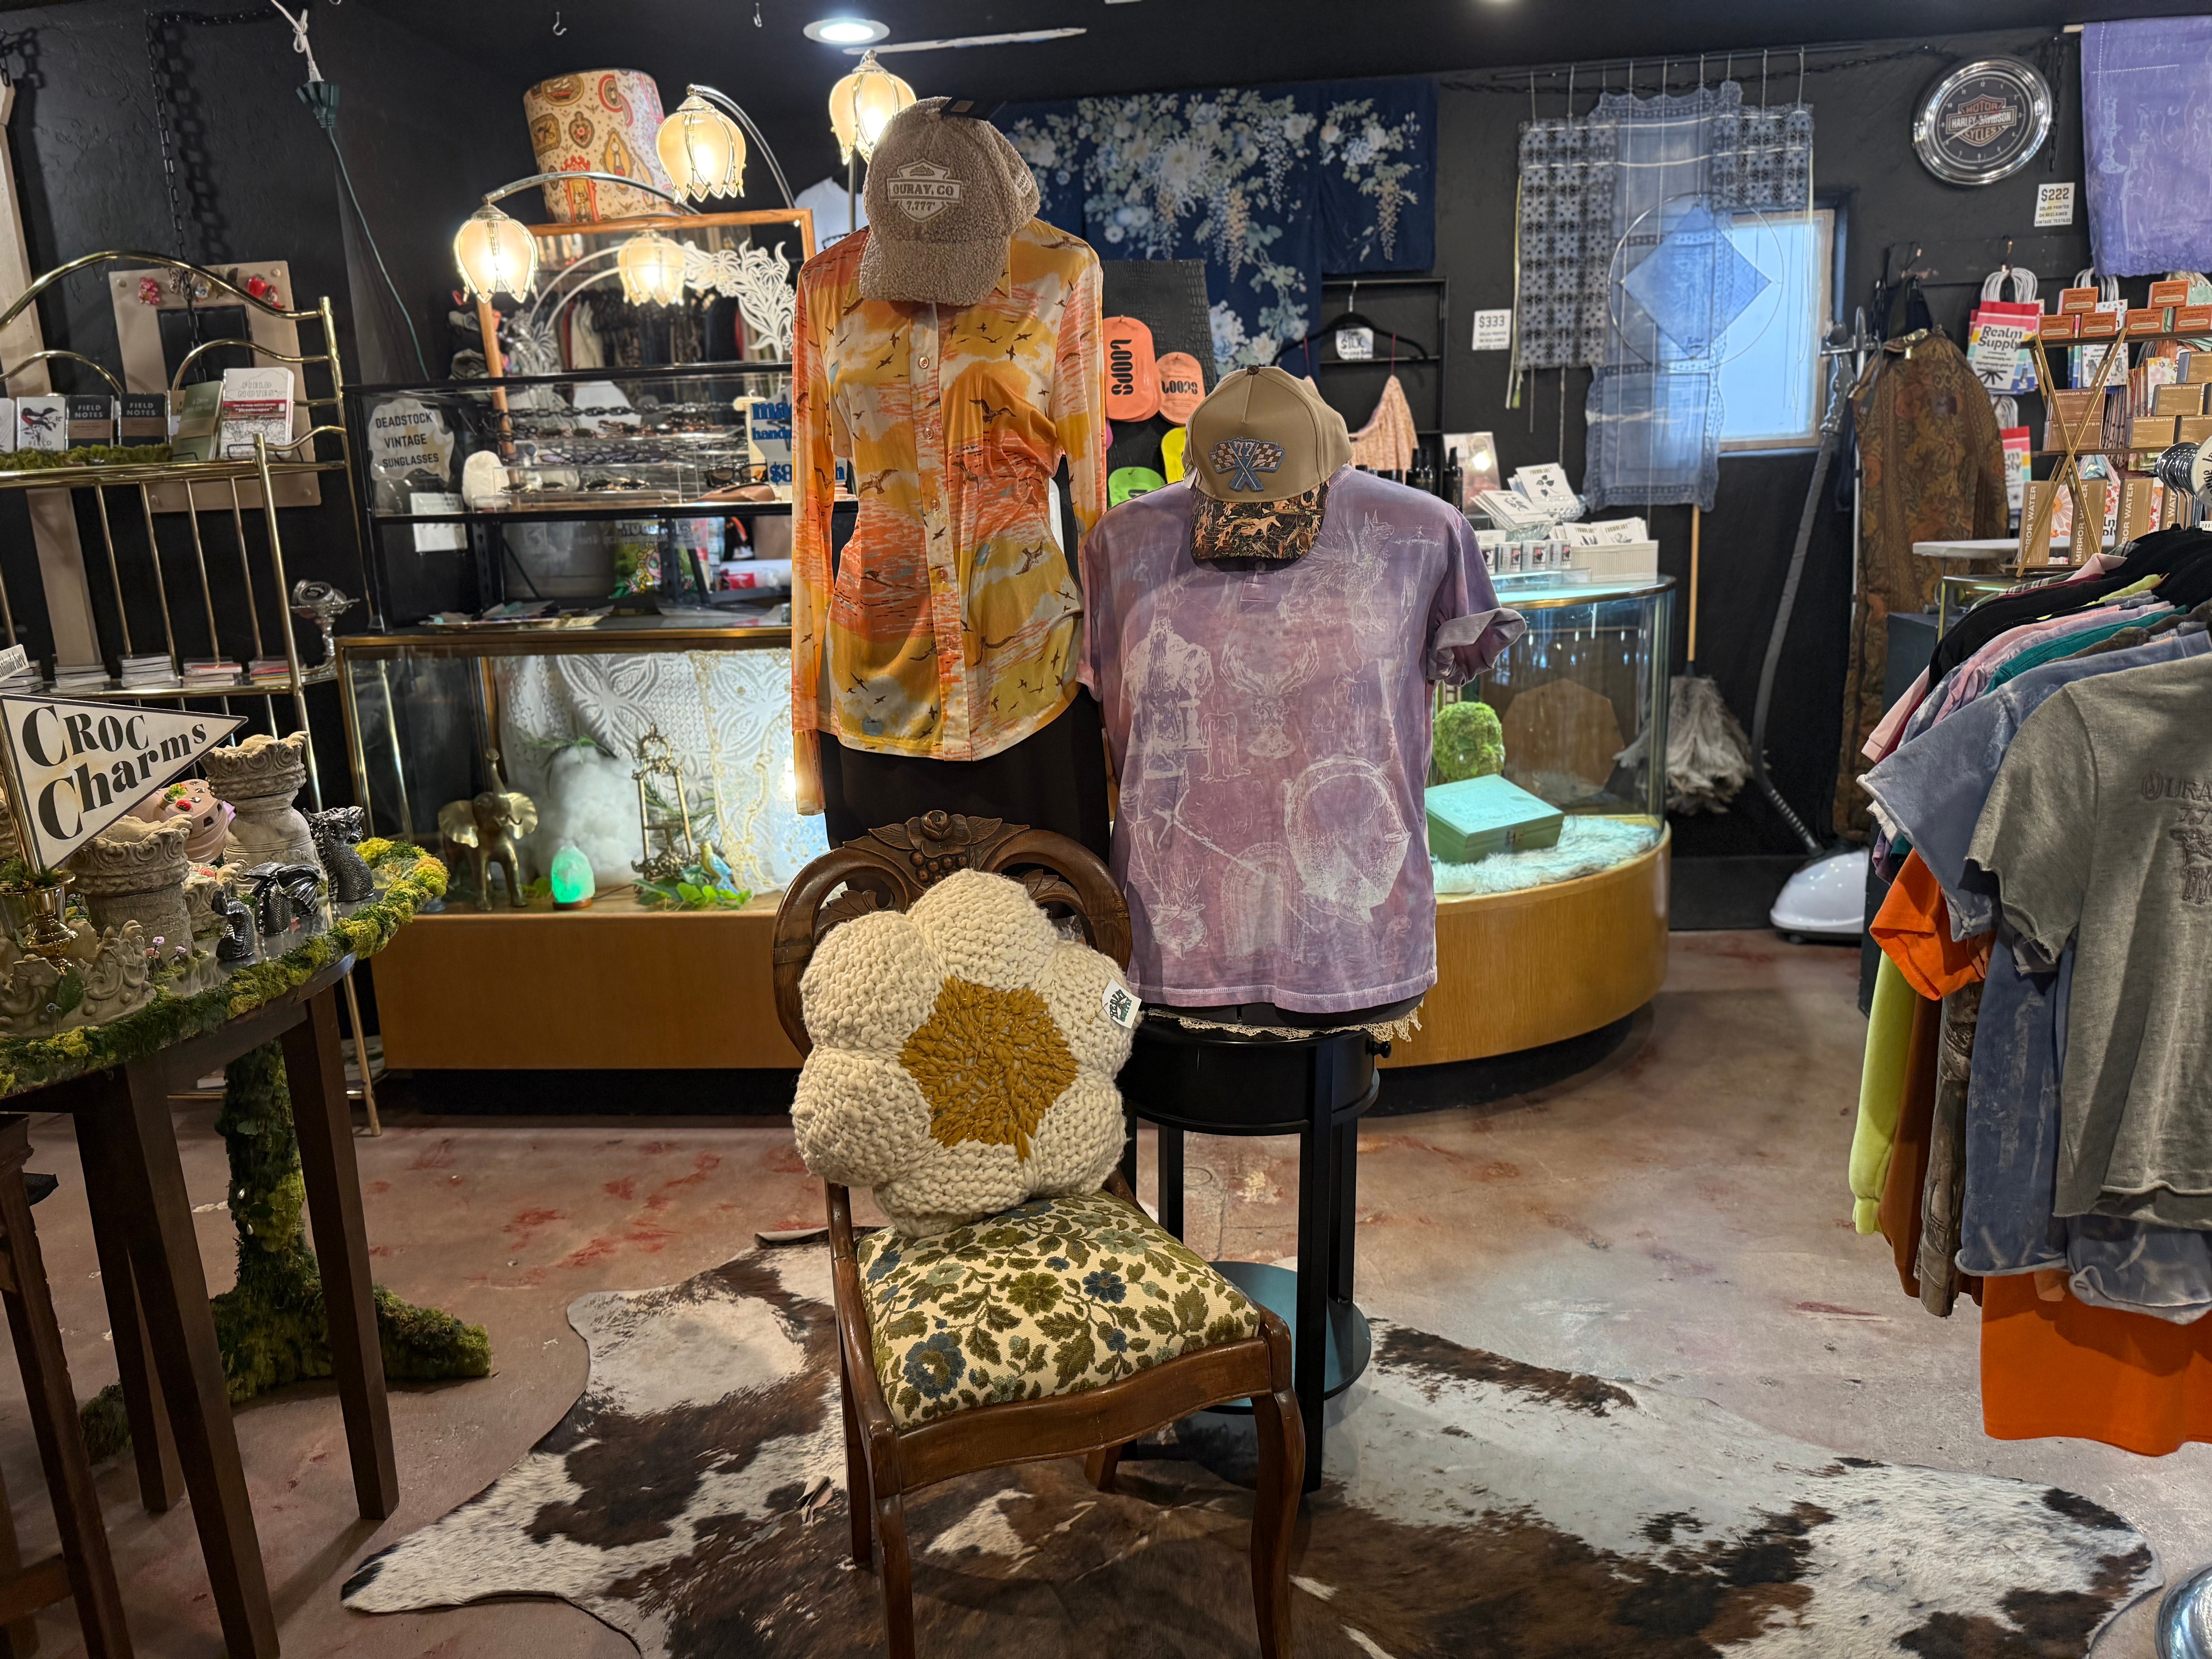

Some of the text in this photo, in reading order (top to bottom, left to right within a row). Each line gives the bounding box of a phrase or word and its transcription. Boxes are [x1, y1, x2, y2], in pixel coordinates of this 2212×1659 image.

[1966, 101, 1998, 113] MOTOR
[1964, 126, 1997, 141] CYCLES
[937, 185, 955, 196] CO
[2041, 188, 2069, 202] $222
[1479, 315, 1504, 328] $333
[1982, 326, 2023, 339] Realm
[1110, 339, 1134, 395] LOOPS
[1162, 380, 1198, 395] LOOPS
[375, 412, 433, 428] DEADSTOCK
[384, 434, 428, 448] VINTAGE
[1233, 441, 1255, 458] 77
[383, 453, 439, 468] SUNGLASSES
[2028, 486, 2037, 521] WATER
[2124, 483, 2134, 519] WATER
[2168, 489, 2176, 518] WATE
[2075, 523, 2085, 562] MIRROR
[22, 705, 150, 767] CROC
[38, 723, 207, 840] Charms
